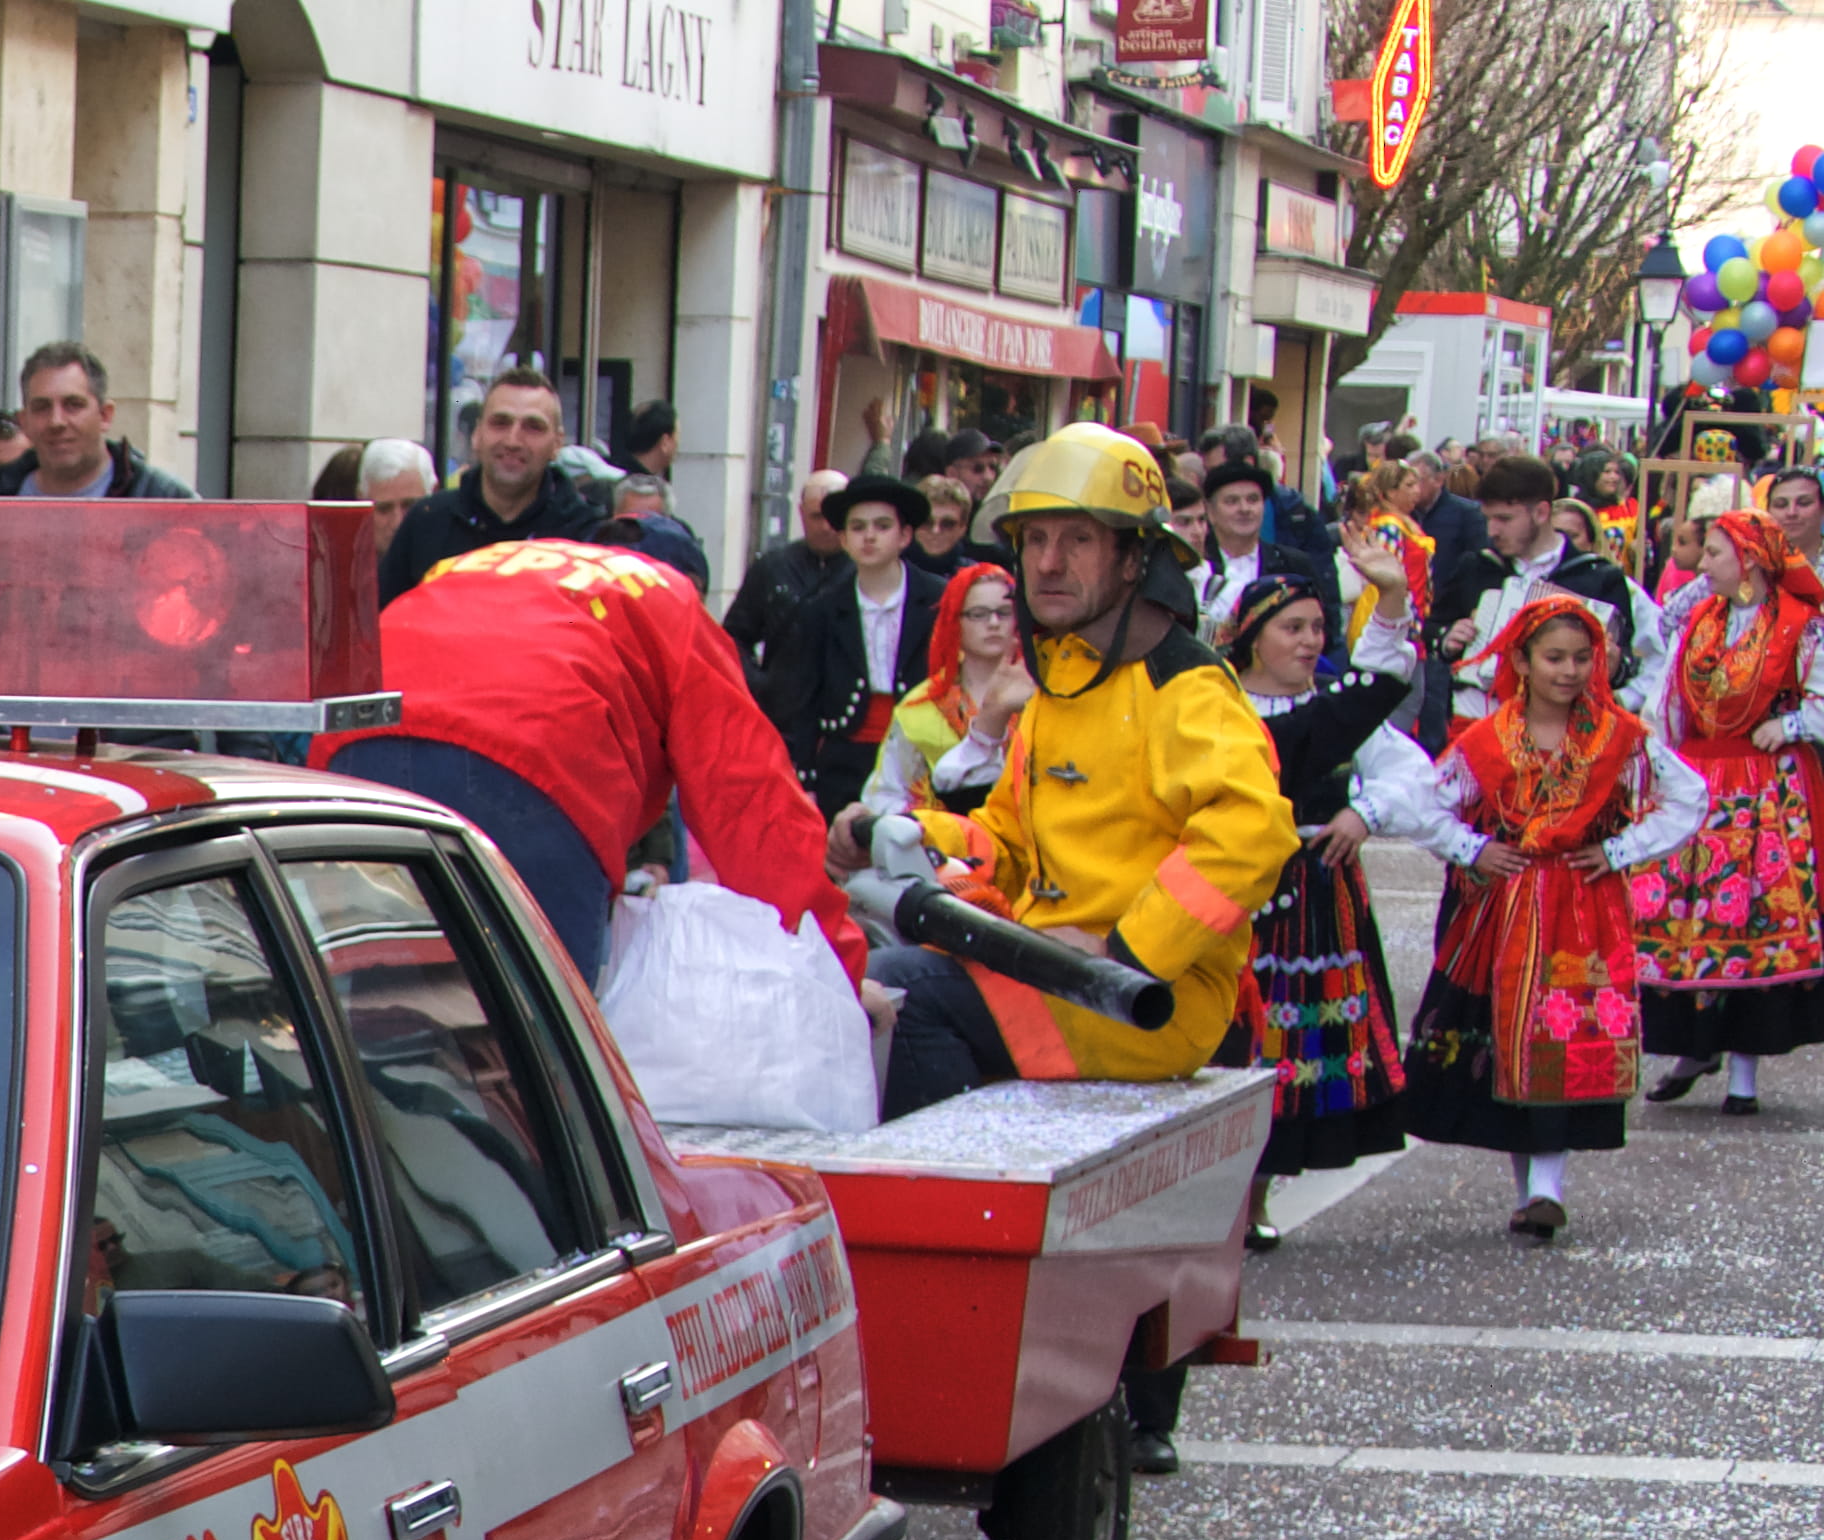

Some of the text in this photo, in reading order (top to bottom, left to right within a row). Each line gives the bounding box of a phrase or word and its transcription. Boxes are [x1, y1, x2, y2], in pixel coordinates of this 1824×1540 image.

[621, 0, 712, 106] LAGNY
[1118, 36, 1205, 55] boulanger
[1384, 27, 1420, 146] TABAC
[665, 1267, 791, 1400] PHILADELPHIA
